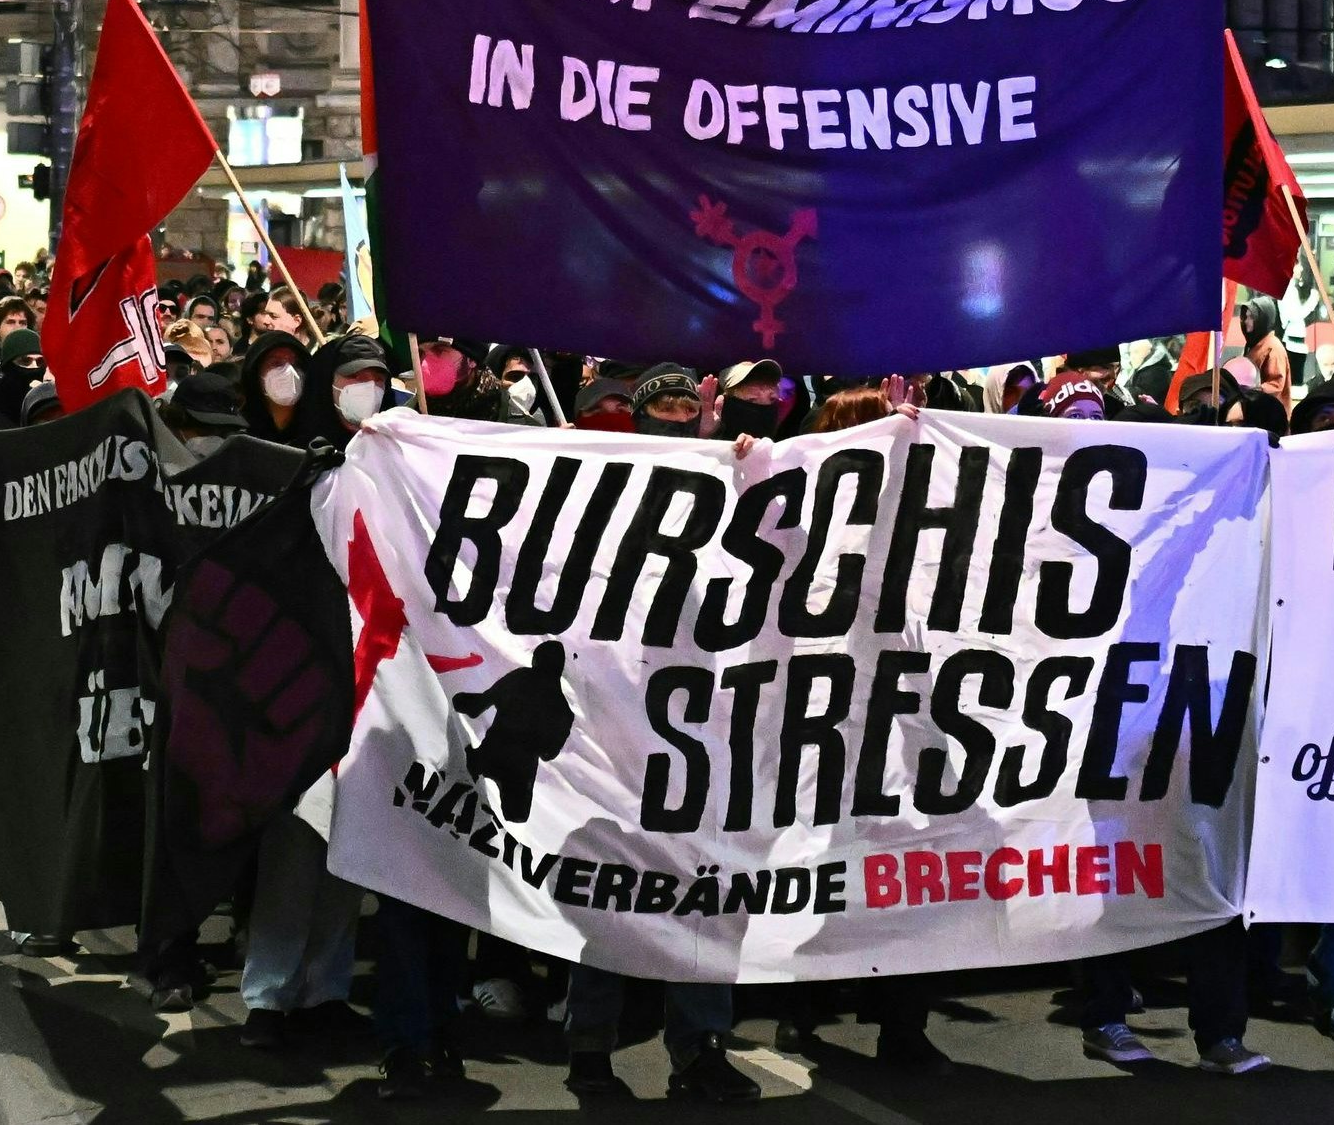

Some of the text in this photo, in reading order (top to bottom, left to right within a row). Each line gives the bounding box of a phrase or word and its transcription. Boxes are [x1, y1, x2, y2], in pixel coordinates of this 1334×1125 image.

[468, 34, 1037, 150] IN DIE OFFENSIVE
[4, 469, 52, 522] DEN
[425, 443, 1147, 653] BURSCHIS
[639, 641, 1256, 834] STRESSEN
[865, 840, 1163, 910] BRECHEN
